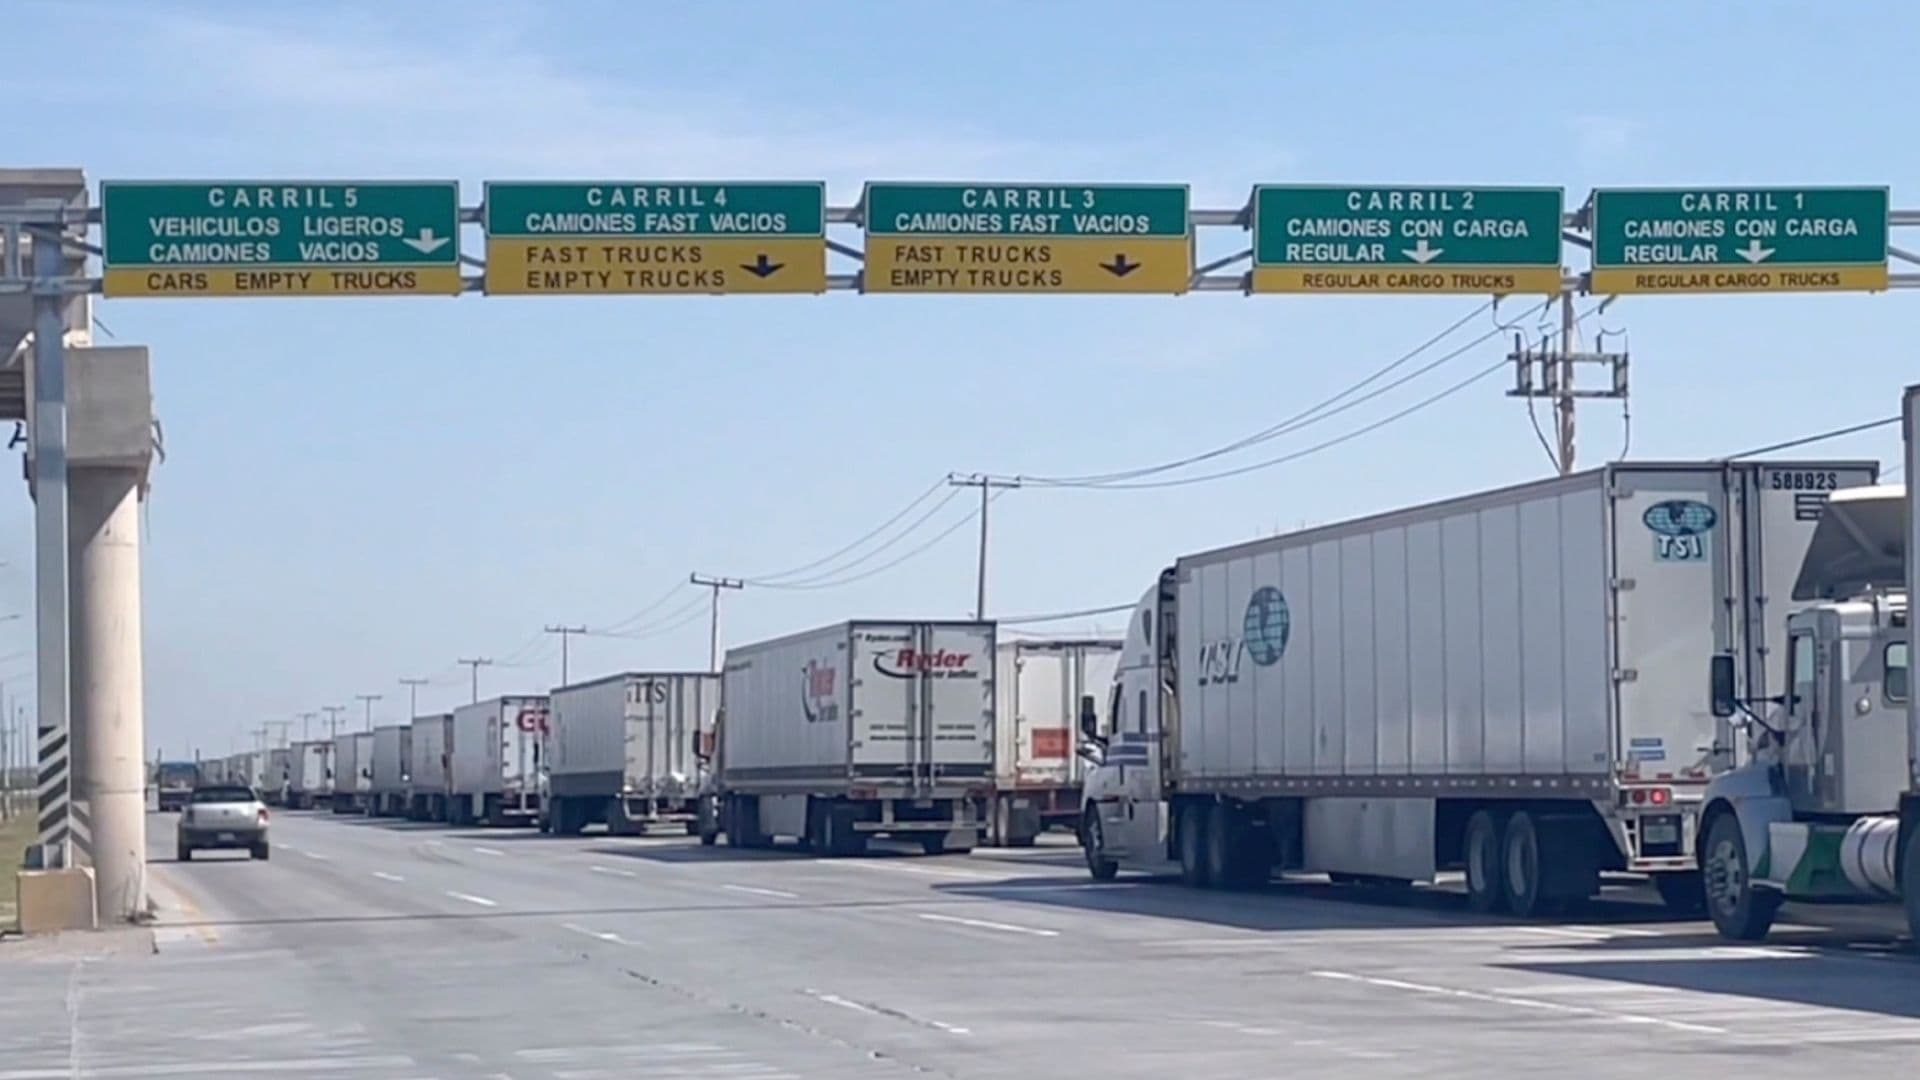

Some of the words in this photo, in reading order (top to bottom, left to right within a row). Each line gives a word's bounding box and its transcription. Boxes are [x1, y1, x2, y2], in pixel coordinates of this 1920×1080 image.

[208, 187, 333, 208] CARRIL
[344, 187, 358, 208] 5
[587, 184, 705, 208] CARRIL
[714, 187, 727, 207] 4
[962, 188, 1073, 209] CARRIL
[1083, 189, 1095, 209] 3
[1347, 191, 1453, 211] CARRIL
[1462, 191, 1475, 210] 2
[1681, 192, 1778, 212] CARRIL
[1794, 192, 1804, 209] 1
[149, 216, 281, 237] VEHICULOS
[303, 215, 404, 237] LIGEROS
[526, 212, 637, 233] CAMIONES
[644, 212, 700, 232] FAST
[709, 212, 787, 232] VACIOS
[894, 213, 1003, 233] CAMIONES
[1009, 213, 1061, 233] FAST
[1072, 214, 1150, 234] VACIOS
[1287, 218, 1391, 238] CAMIONES
[1400, 219, 1444, 238] CON
[1453, 219, 1529, 238] CARGA
[1624, 219, 1726, 238] CAMIONES
[1734, 219, 1777, 237] CON
[1785, 218, 1858, 237] CARGA
[149, 242, 271, 263] CAMIONES
[298, 241, 381, 262] VACIOS
[526, 246, 589, 264] FAST
[601, 245, 702, 264] TRUCKS
[895, 245, 943, 264] FAST
[955, 245, 1051, 264] TRUCKS
[1286, 243, 1386, 262] REGULAR
[1623, 244, 1719, 264] REGULAR
[147, 272, 208, 291] CARS
[234, 271, 312, 291] EMPTY
[330, 270, 417, 290] TRUCKS
[526, 270, 612, 289] EMPTY
[623, 269, 725, 288] TRUCKS
[890, 268, 959, 287] EMPTY
[966, 269, 1063, 288] TRUCKS
[1302, 273, 1380, 288] REGULAR
[1386, 273, 1445, 289] CARGO
[1451, 273, 1515, 289] TRUCKS
[1635, 273, 1710, 289] REGULAR
[1714, 273, 1771, 288] CARGO
[1779, 271, 1840, 287] TRUCKS
[1657, 534, 1703, 558] TSI
[896, 647, 971, 673] Ryder
